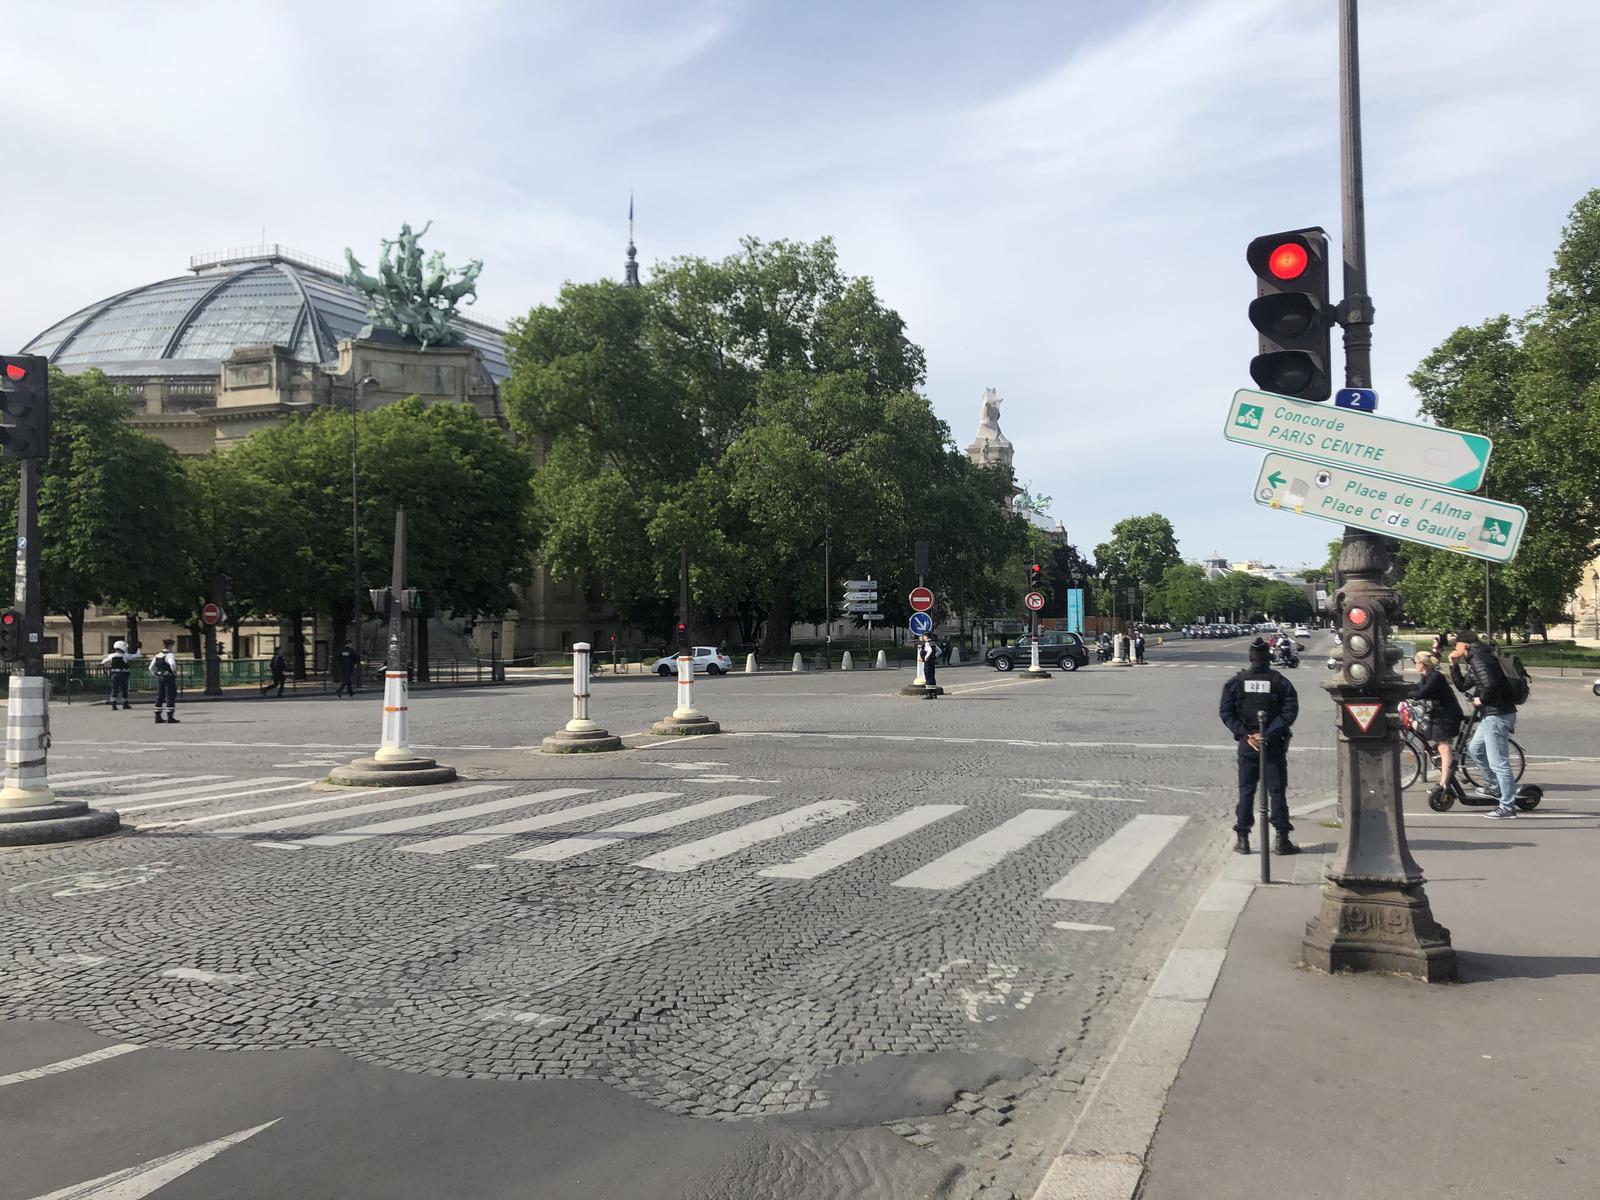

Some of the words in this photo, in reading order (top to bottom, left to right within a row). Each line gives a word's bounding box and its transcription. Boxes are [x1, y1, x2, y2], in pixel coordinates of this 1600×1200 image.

[1350, 392, 1361, 406] 2
[1274, 406, 1345, 432] Concorde
[1268, 425, 1316, 446] PARIS
[1320, 437, 1386, 461] CENTRE
[1321, 495, 1364, 516] Place
[1416, 518, 1467, 541] Gaulle
[1344, 480, 1388, 501] Place
[1393, 493, 1414, 507] de
[1420, 498, 1473, 521] l'Alma
